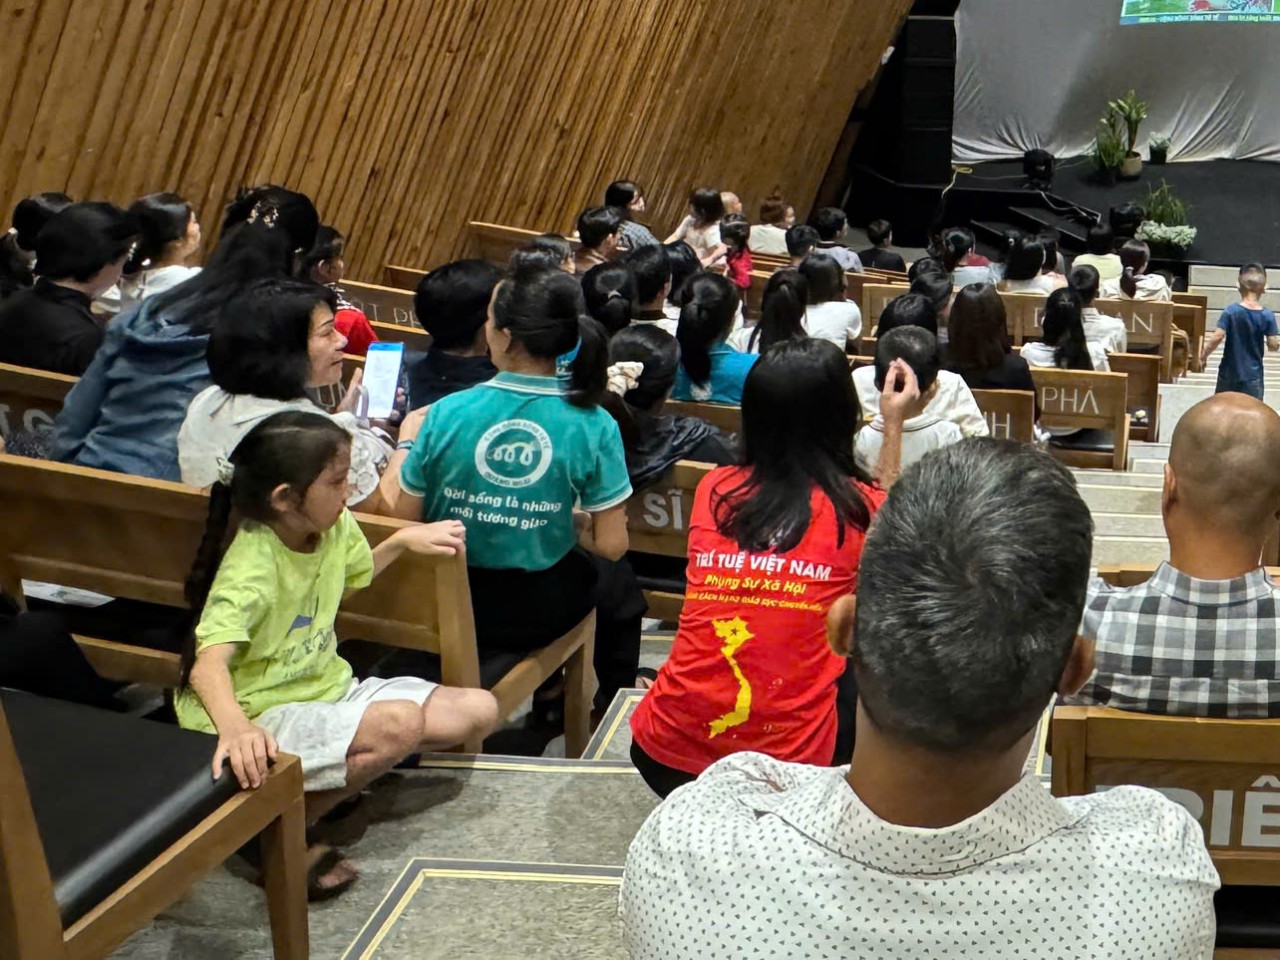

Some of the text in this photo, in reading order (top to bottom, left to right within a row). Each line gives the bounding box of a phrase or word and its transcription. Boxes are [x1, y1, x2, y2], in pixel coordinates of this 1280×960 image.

[444, 487, 562, 514] Đời sống là những
[643, 488, 683, 531] SĨ
[477, 510, 518, 528] tương
[520, 518, 549, 531] giao
[696, 548, 832, 582] TRÍ TUỆ VIỆT NAM
[704, 574, 740, 591] Phụng
[783, 580, 807, 597] Hội
